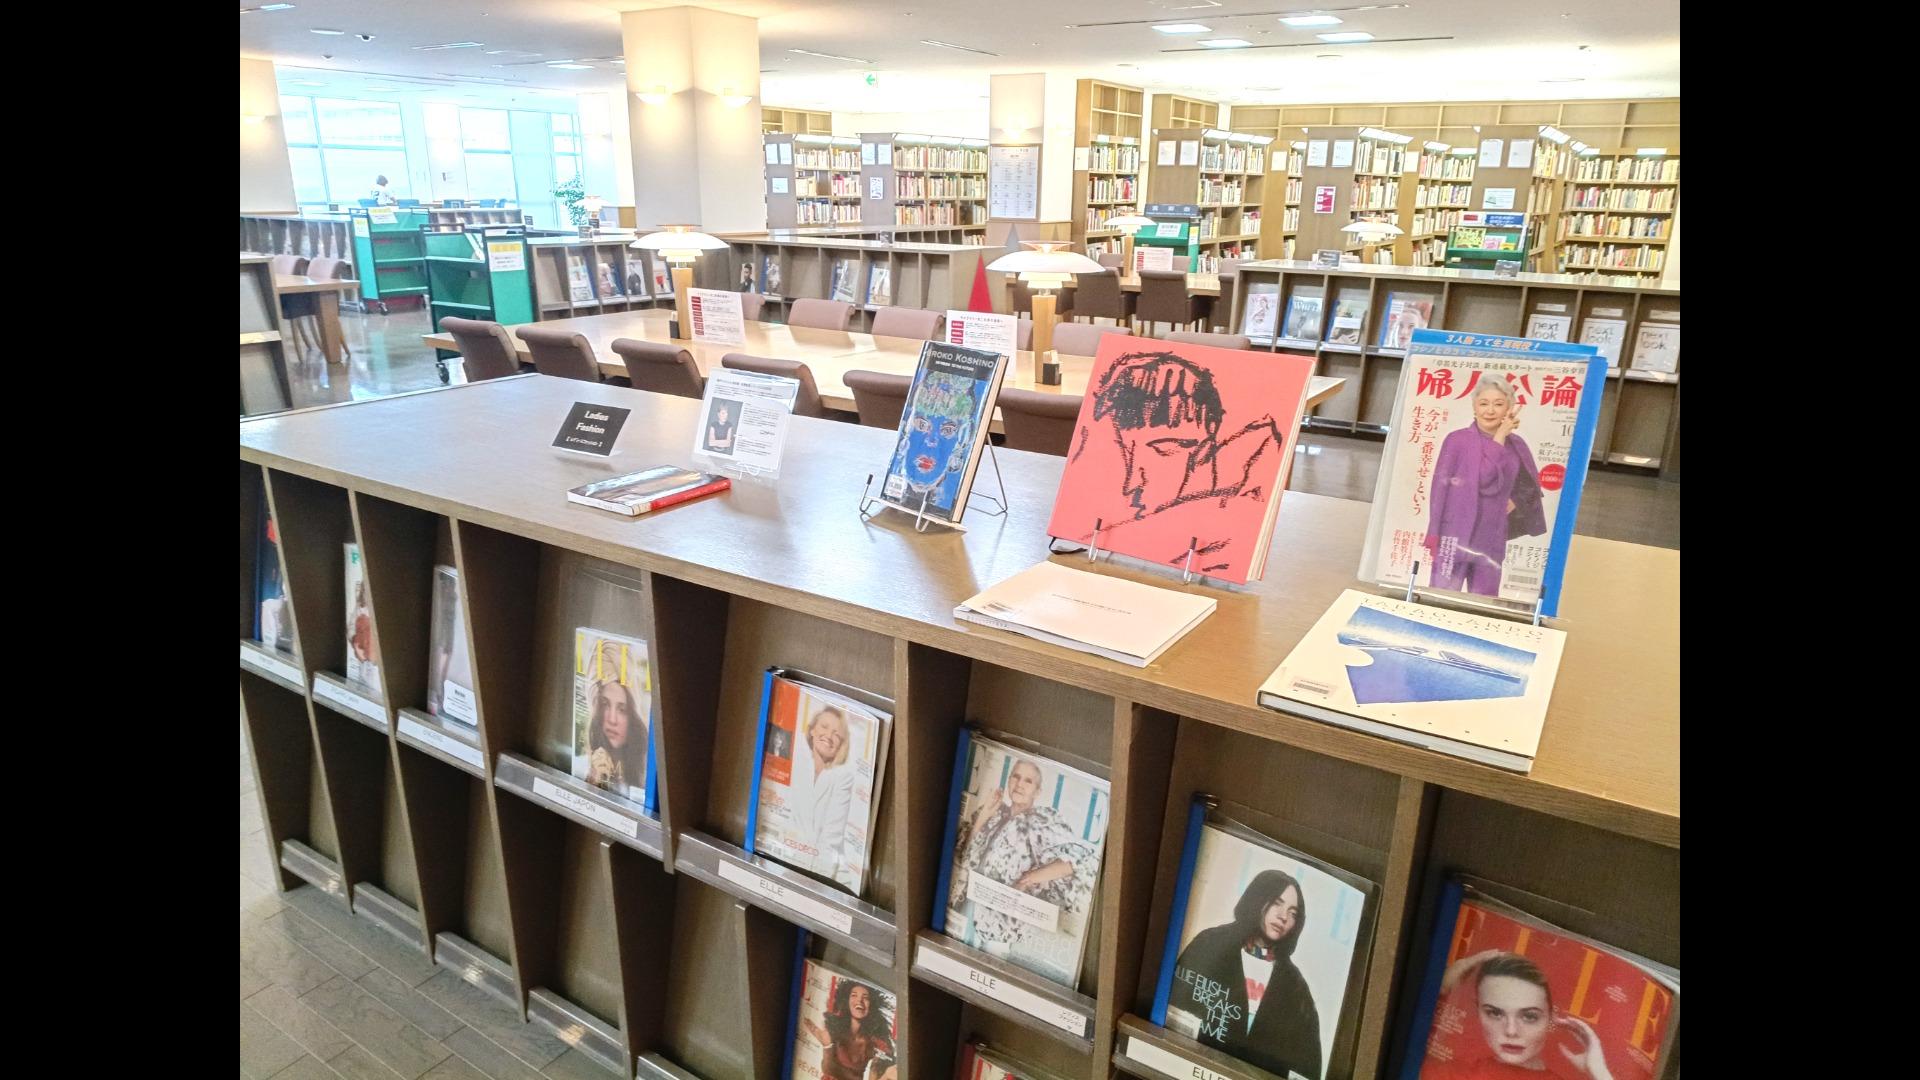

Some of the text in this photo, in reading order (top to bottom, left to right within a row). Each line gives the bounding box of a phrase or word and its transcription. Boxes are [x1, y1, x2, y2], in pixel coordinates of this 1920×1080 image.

[955, 353, 995, 368] KOSHINO
[584, 410, 609, 422] Ladies
[1408, 405, 1426, 444] 生き方
[575, 422, 605, 434] Fashion
[555, 788, 572, 802] ELLE
[759, 879, 785, 897] ELLE
[969, 969, 996, 990] ELLE
[1192, 986, 1242, 1021] BREAKS
[1206, 1006, 1231, 1033] THE
